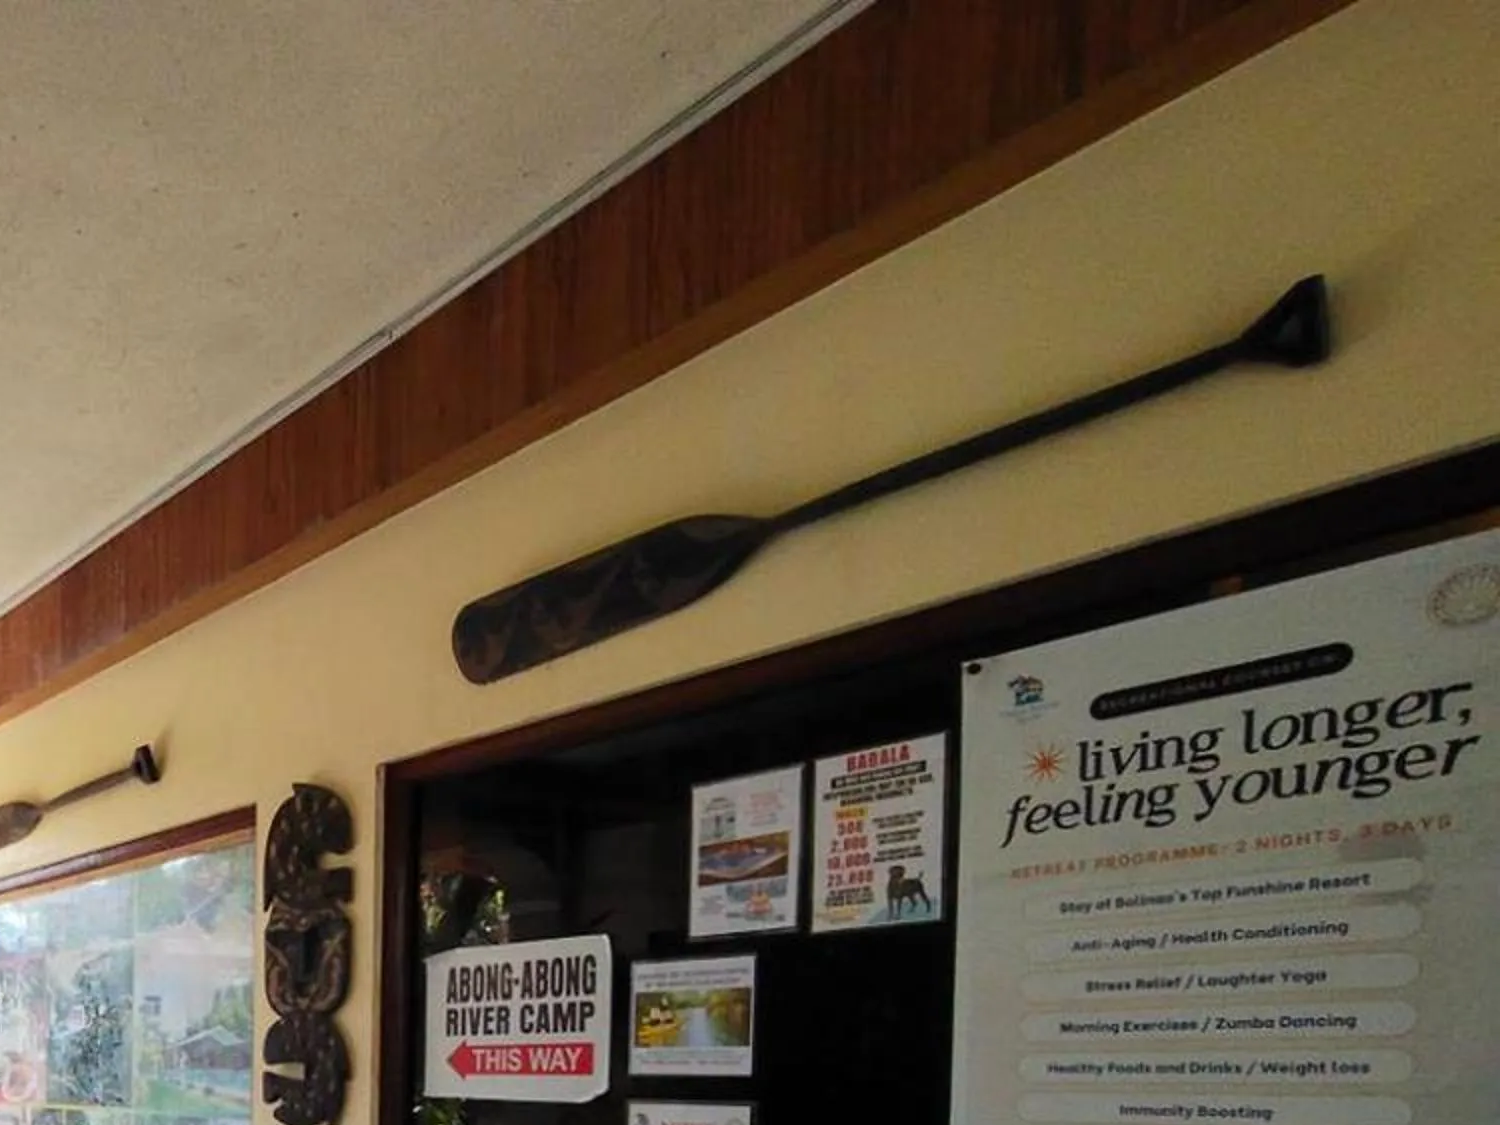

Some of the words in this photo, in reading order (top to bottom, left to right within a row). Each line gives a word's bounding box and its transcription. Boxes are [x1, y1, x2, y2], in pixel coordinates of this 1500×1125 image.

[1076, 728, 1225, 782] living
[1241, 682, 1474, 755] longer,
[1000, 783, 1180, 849] feeling
[1193, 735, 1481, 823] younger
[1010, 860, 1087, 881] RETREAT
[1358, 822, 1372, 839] 3
[1379, 815, 1453, 837] DAYS
[1191, 888, 1223, 904] Top
[1227, 878, 1304, 899] Funshine
[1308, 872, 1372, 890] Resort
[1071, 935, 1157, 952] Anti-Aging
[1171, 929, 1228, 946] Health
[1233, 921, 1350, 942] Conditioning
[446, 953, 598, 1004] ABONG-ABONG
[1085, 979, 1131, 993] Stress
[1135, 975, 1181, 991] Relief
[1197, 972, 1274, 989] Laughter
[1280, 970, 1328, 985] Yoga
[445, 1005, 512, 1037] RIVER
[519, 1000, 596, 1035] CAMP
[1059, 1020, 1120, 1035] Morning
[1123, 1018, 1198, 1033] Exercises
[1214, 1016, 1275, 1030] Zumba
[1278, 1014, 1357, 1030] Dancing
[470, 1047, 522, 1072] THIS
[528, 1046, 584, 1072] WAY
[1046, 1062, 1103, 1077] Healthy
[1106, 1061, 1152, 1075] Foods
[1155, 1061, 1186, 1075] and
[1189, 1060, 1242, 1075] Drinks
[1259, 1060, 1326, 1077] Weight
[1118, 1102, 1193, 1120] Immunity
[1197, 1104, 1275, 1122] Boosting
